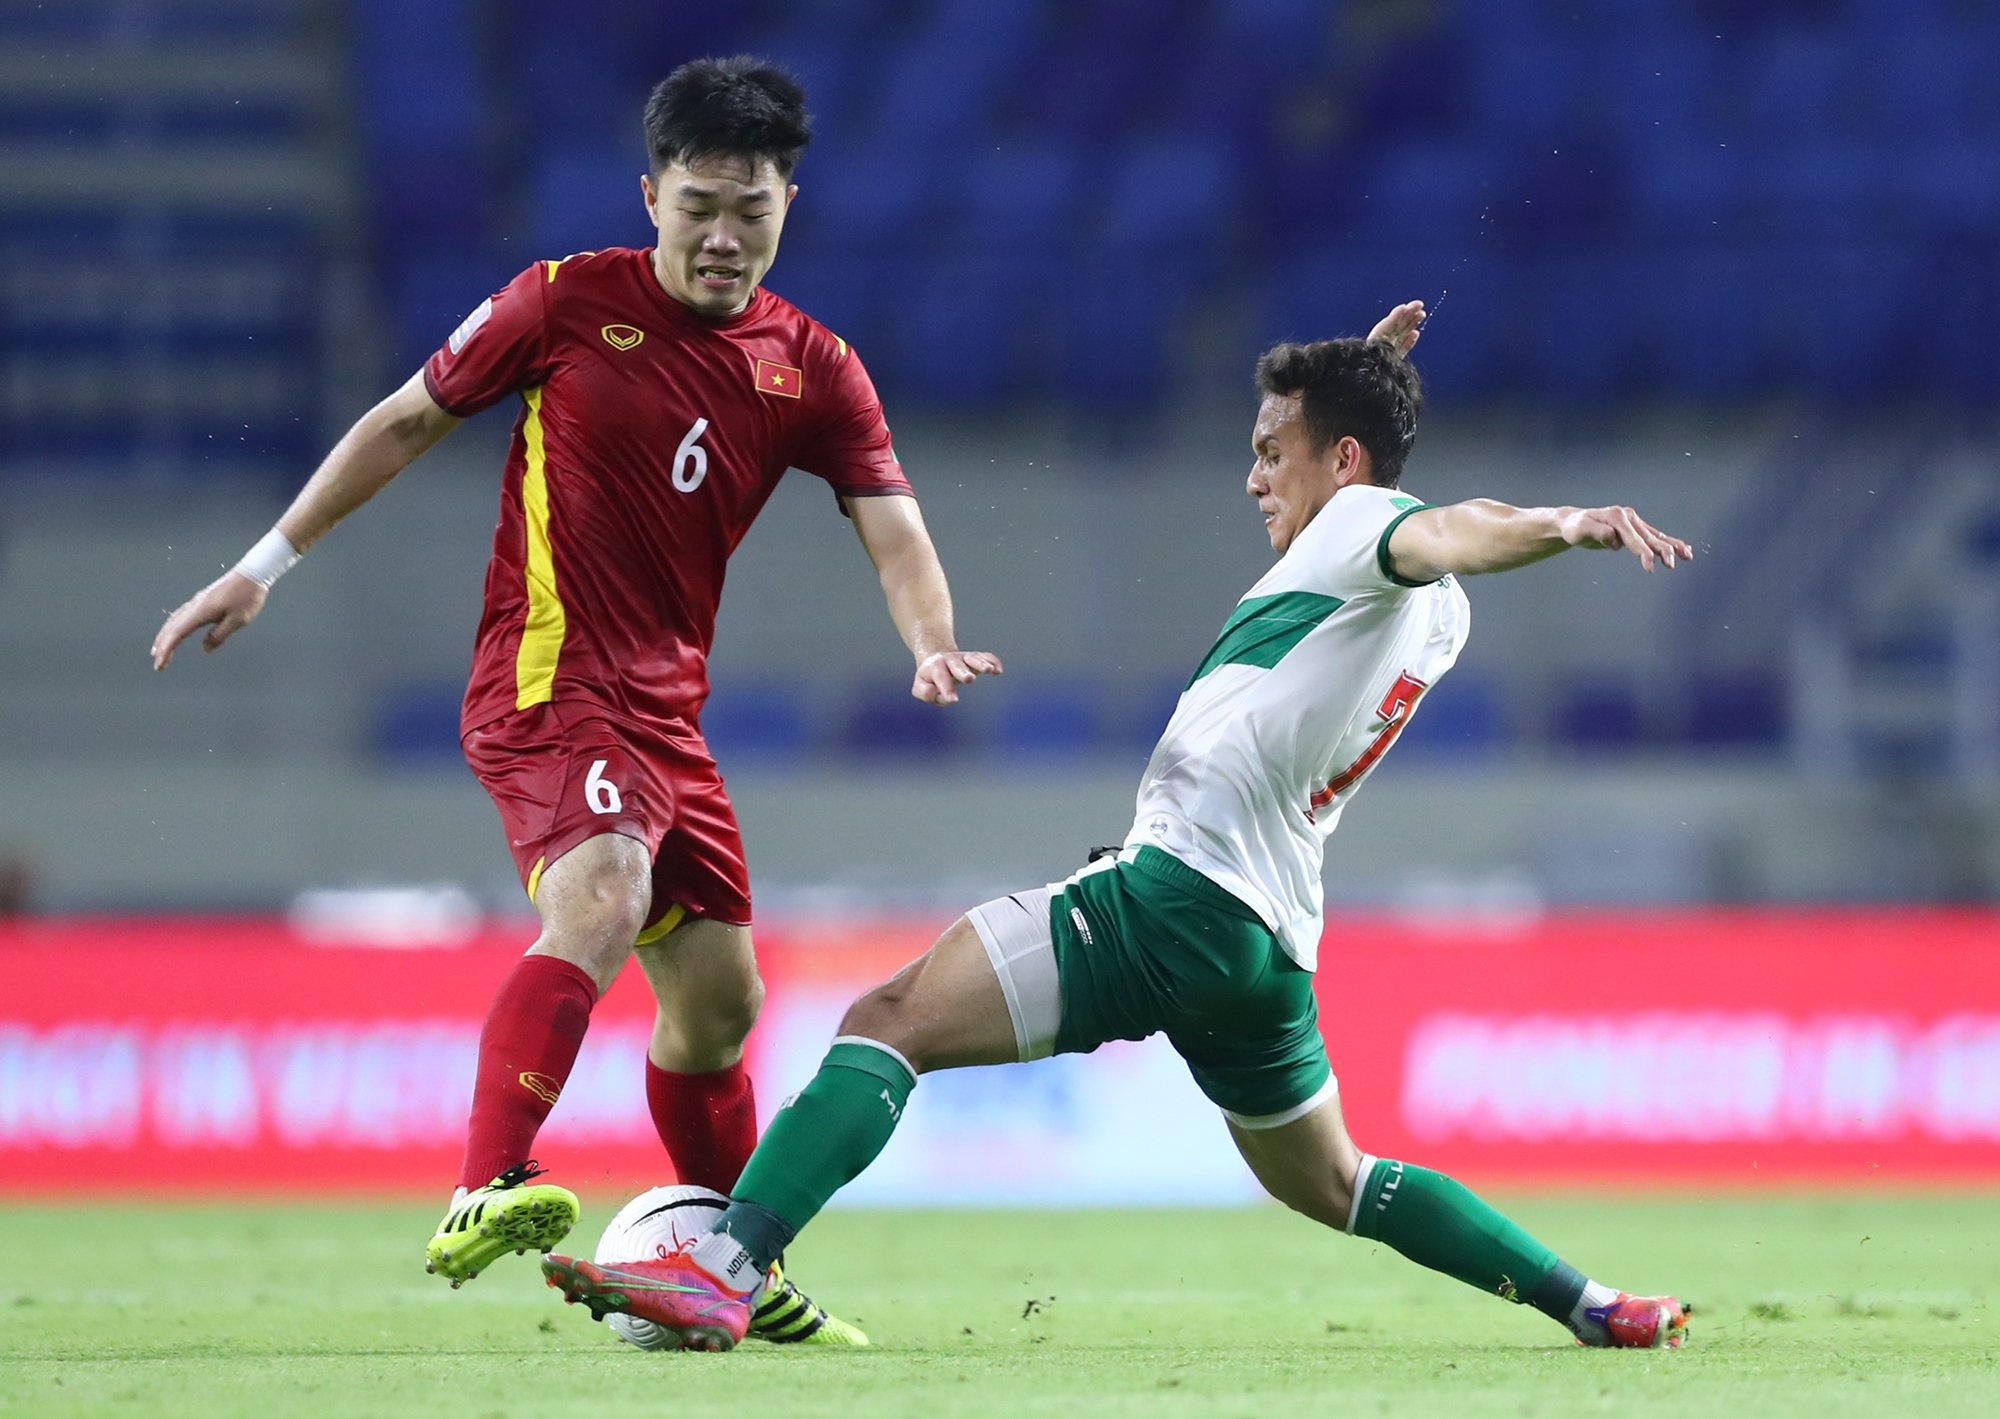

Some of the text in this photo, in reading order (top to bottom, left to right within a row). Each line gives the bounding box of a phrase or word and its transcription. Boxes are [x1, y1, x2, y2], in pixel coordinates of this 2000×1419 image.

[671, 417, 709, 493] 6
[1303, 669, 1428, 826] 7
[584, 759, 623, 815] 6
